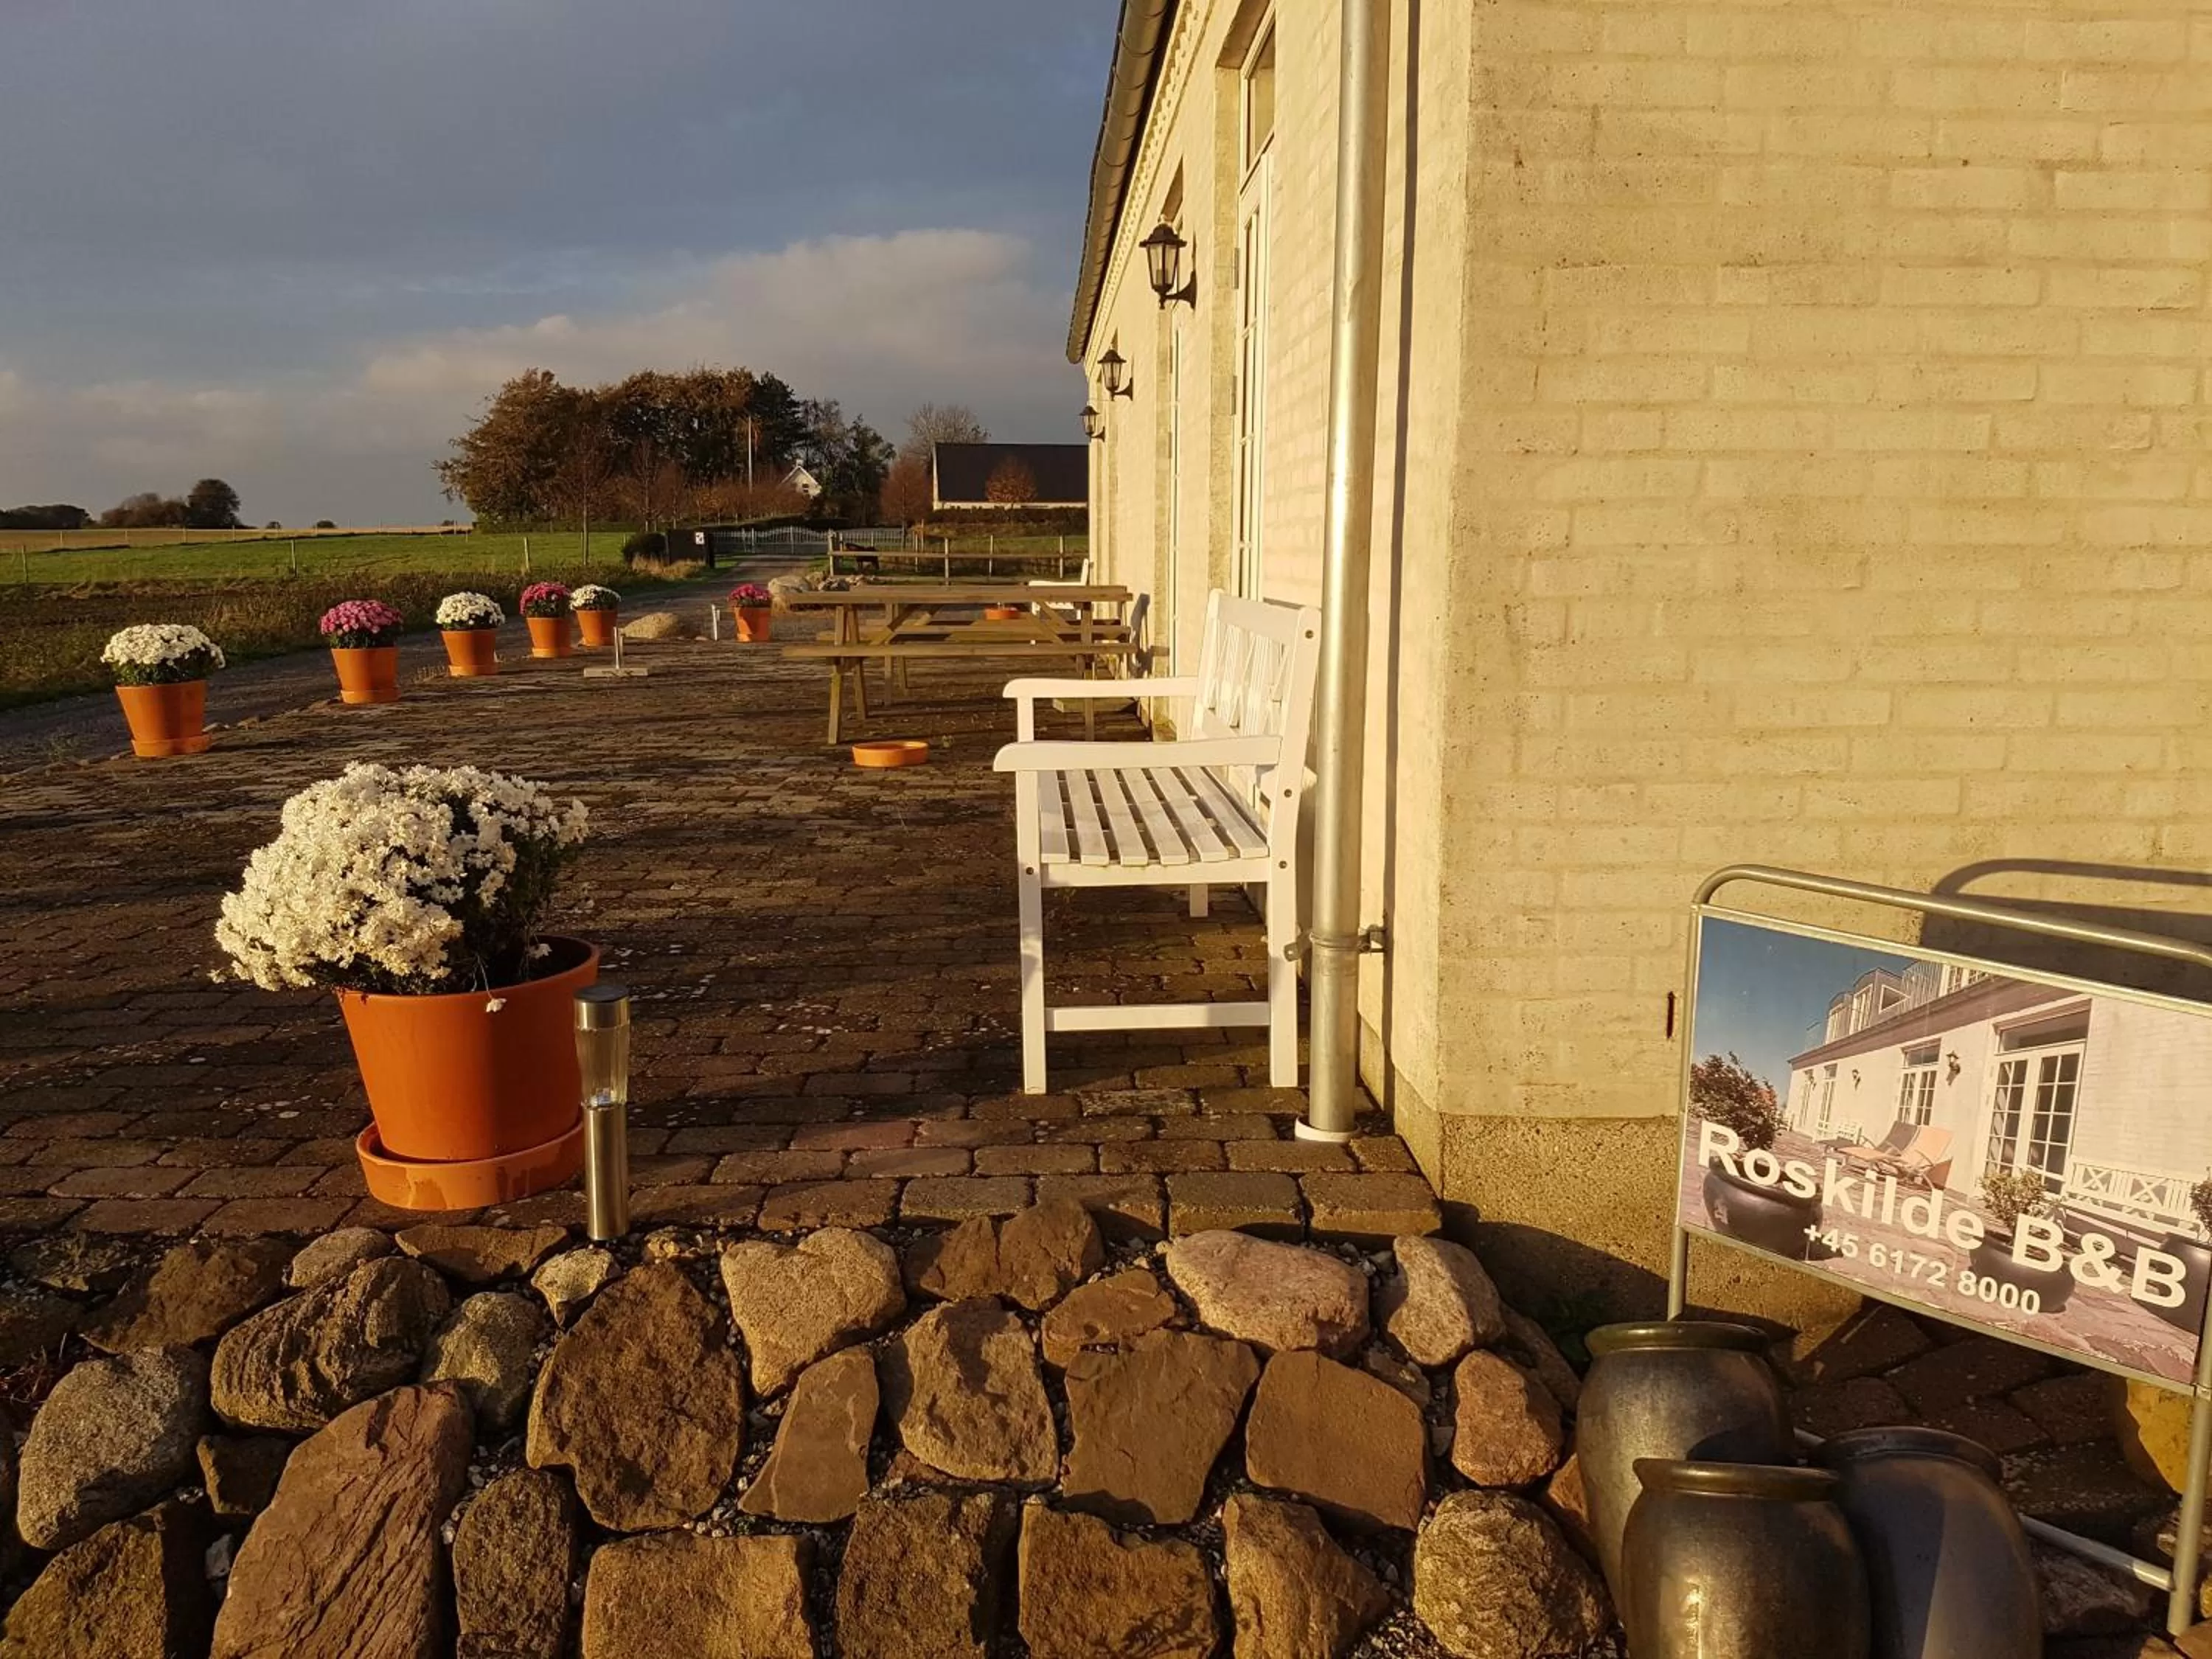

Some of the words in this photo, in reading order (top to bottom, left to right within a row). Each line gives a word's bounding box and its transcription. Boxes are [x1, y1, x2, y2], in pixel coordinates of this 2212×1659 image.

[1699, 1121, 1984, 1250] Roskilde
[2011, 1214, 2187, 1309] B&B
[1804, 1225, 1859, 1258] +45
[1869, 1244, 1947, 1287] 6172
[1958, 1270, 2041, 1315] 8000
